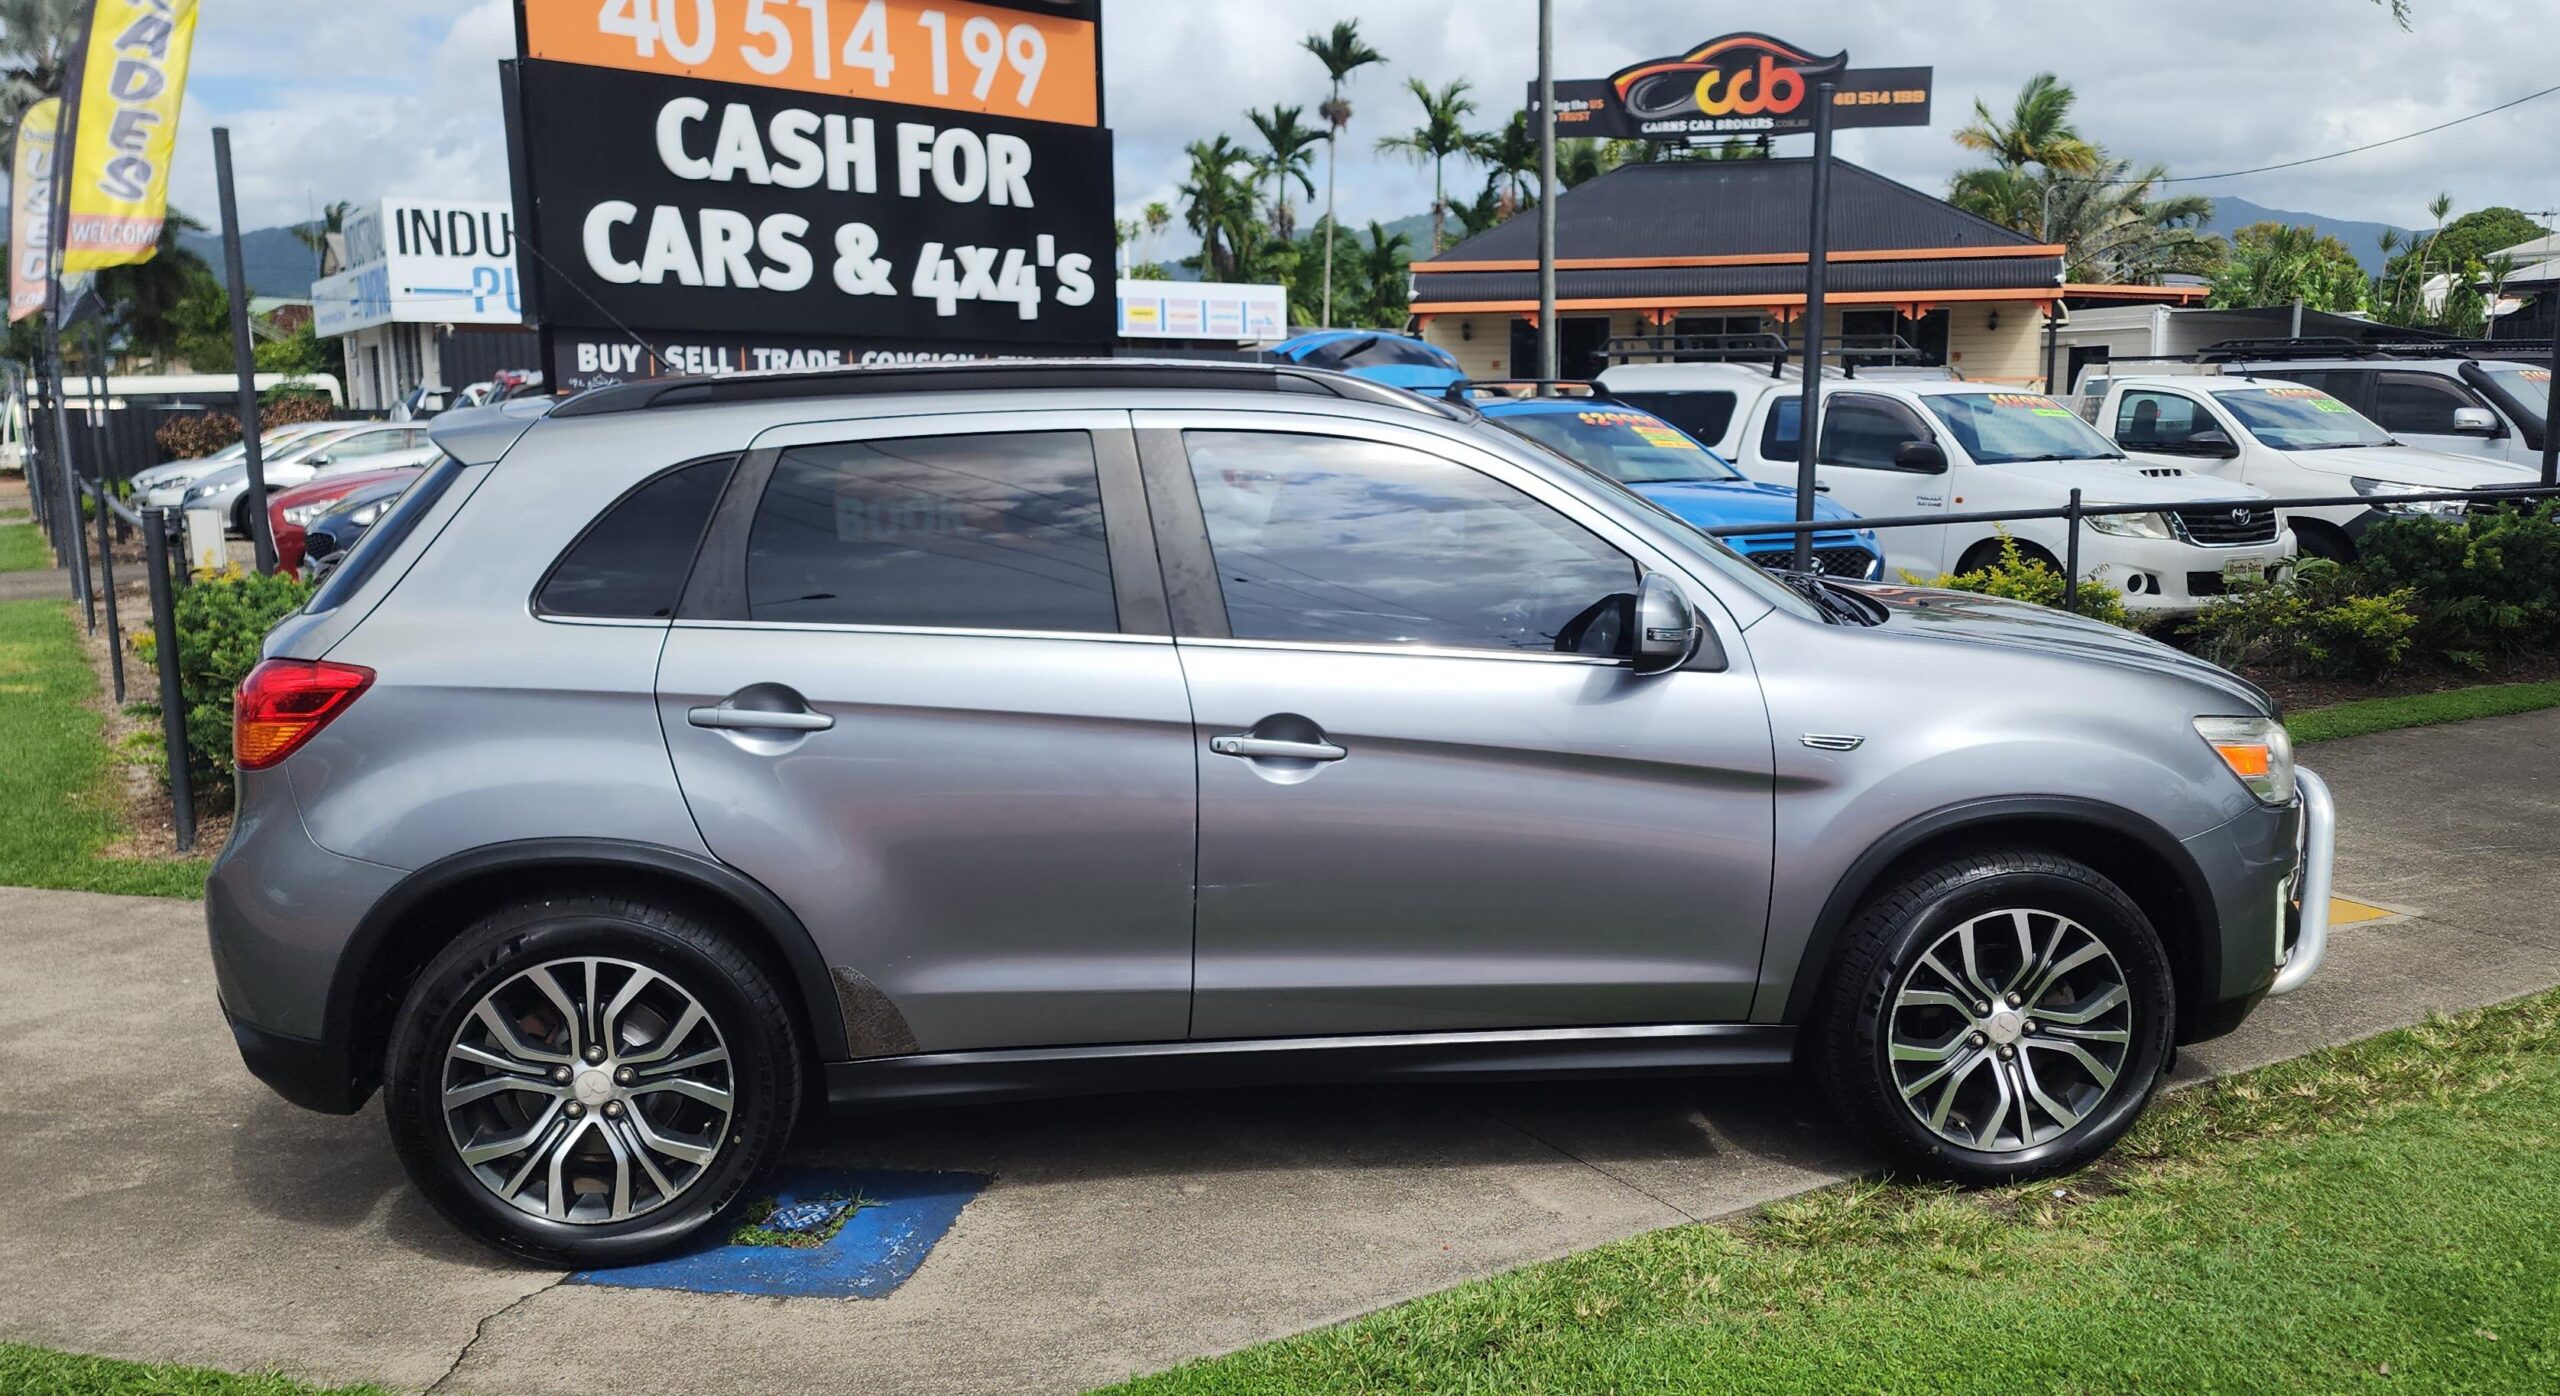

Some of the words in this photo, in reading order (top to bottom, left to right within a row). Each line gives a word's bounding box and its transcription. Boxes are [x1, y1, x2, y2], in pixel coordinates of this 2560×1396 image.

[597, 0, 717, 65] 40
[740, 0, 895, 88] 514
[917, 10, 1048, 108] 199
[100, 0, 176, 200] ADES
[1558, 111, 1591, 122] TRUST
[1641, 121, 1687, 133] CAIRNS
[1688, 120, 1713, 132] CAR
[1715, 118, 1774, 131] BROKERS
[1858, 91, 1890, 104] 514
[1893, 90, 1926, 103] 199
[655, 97, 877, 193] CASH
[897, 122, 1034, 208] FOR
[582, 200, 813, 292] CARS
[832, 222, 898, 297] &
[577, 343, 642, 373] BUY
[664, 345, 734, 375] SELL
[752, 347, 841, 370] TRADE
